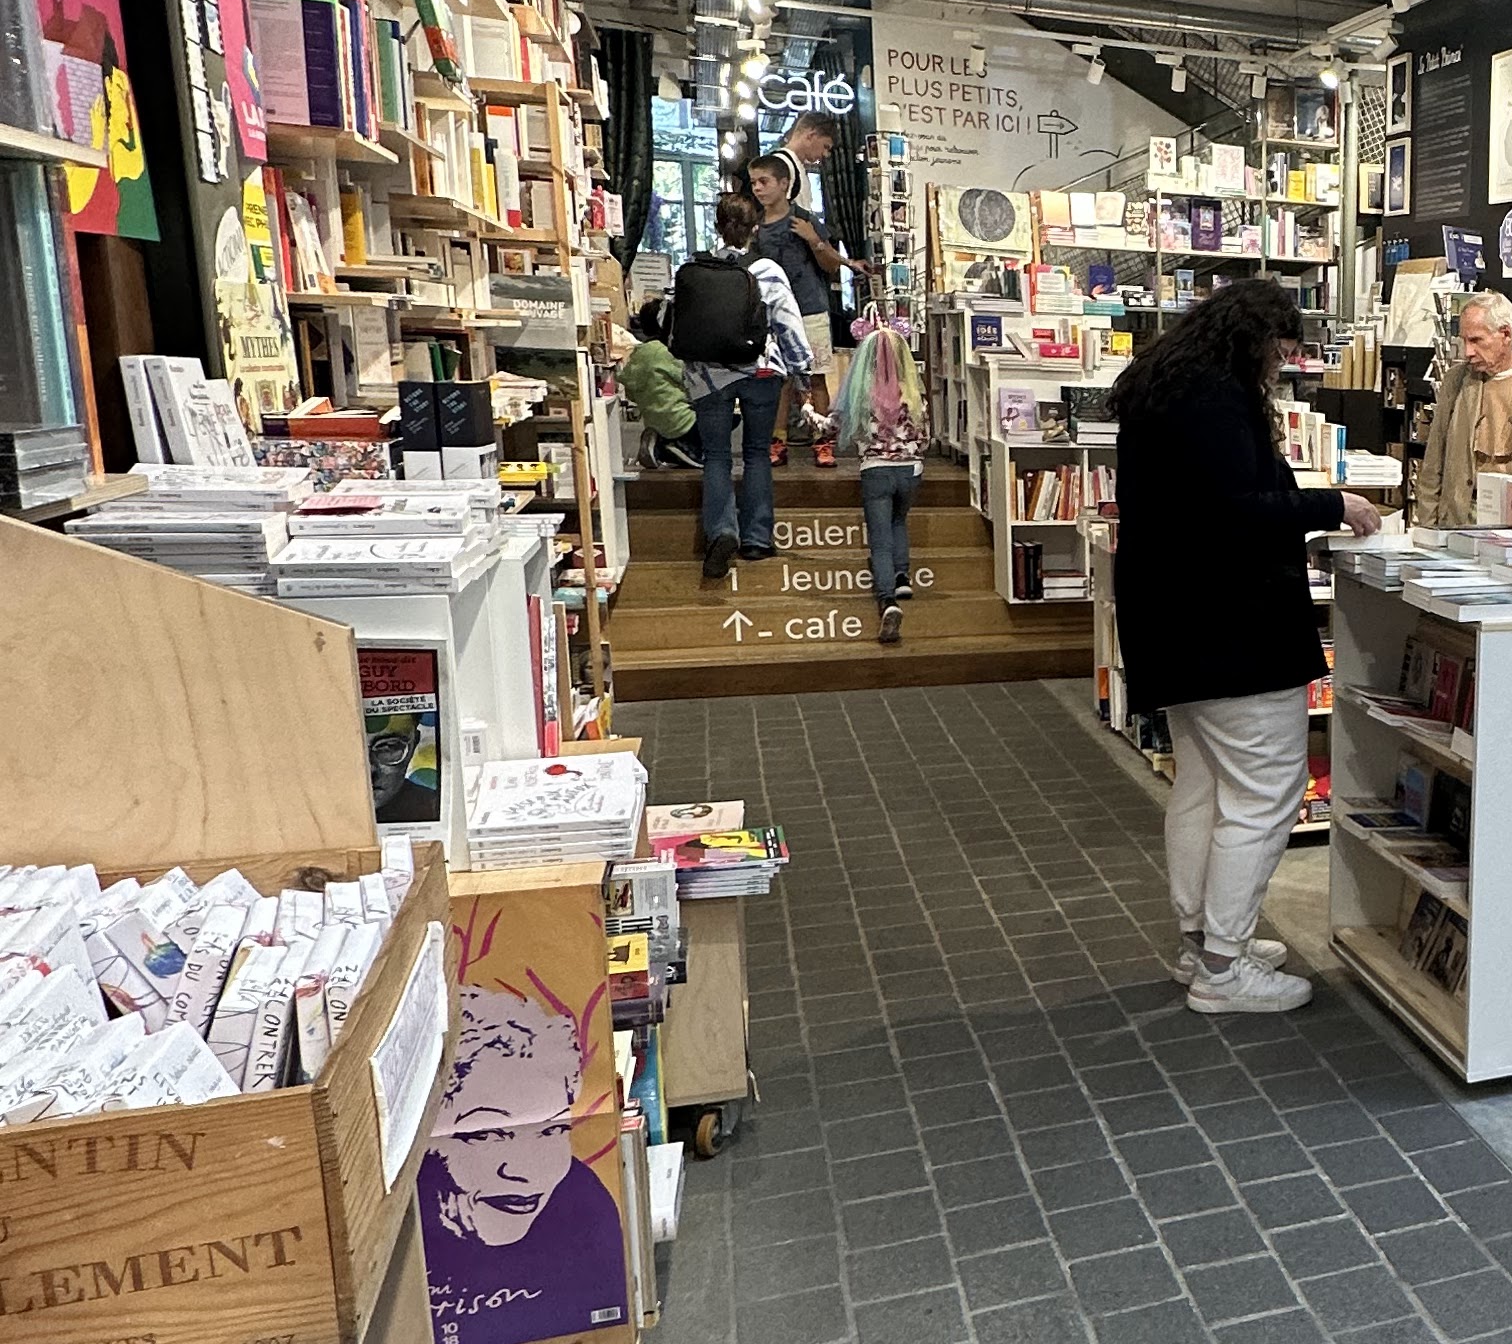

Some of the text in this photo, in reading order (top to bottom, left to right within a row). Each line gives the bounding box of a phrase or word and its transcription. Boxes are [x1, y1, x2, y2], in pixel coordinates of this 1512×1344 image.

[887, 49, 945, 73] POUR
[757, 70, 855, 114] café
[888, 76, 1023, 110] PLUS PETITS,
[952, 109, 990, 130] PAR
[996, 114, 1020, 133] ICI
[240, 336, 279, 358] MYTHES
[773, 519, 869, 550] galeri
[780, 564, 935, 593] Jeunee
[360, 664, 398, 677] GUY
[361, 680, 416, 692] BORD
[0, 1132, 207, 1182] NTIN
[441, 1322, 459, 1335] 10
